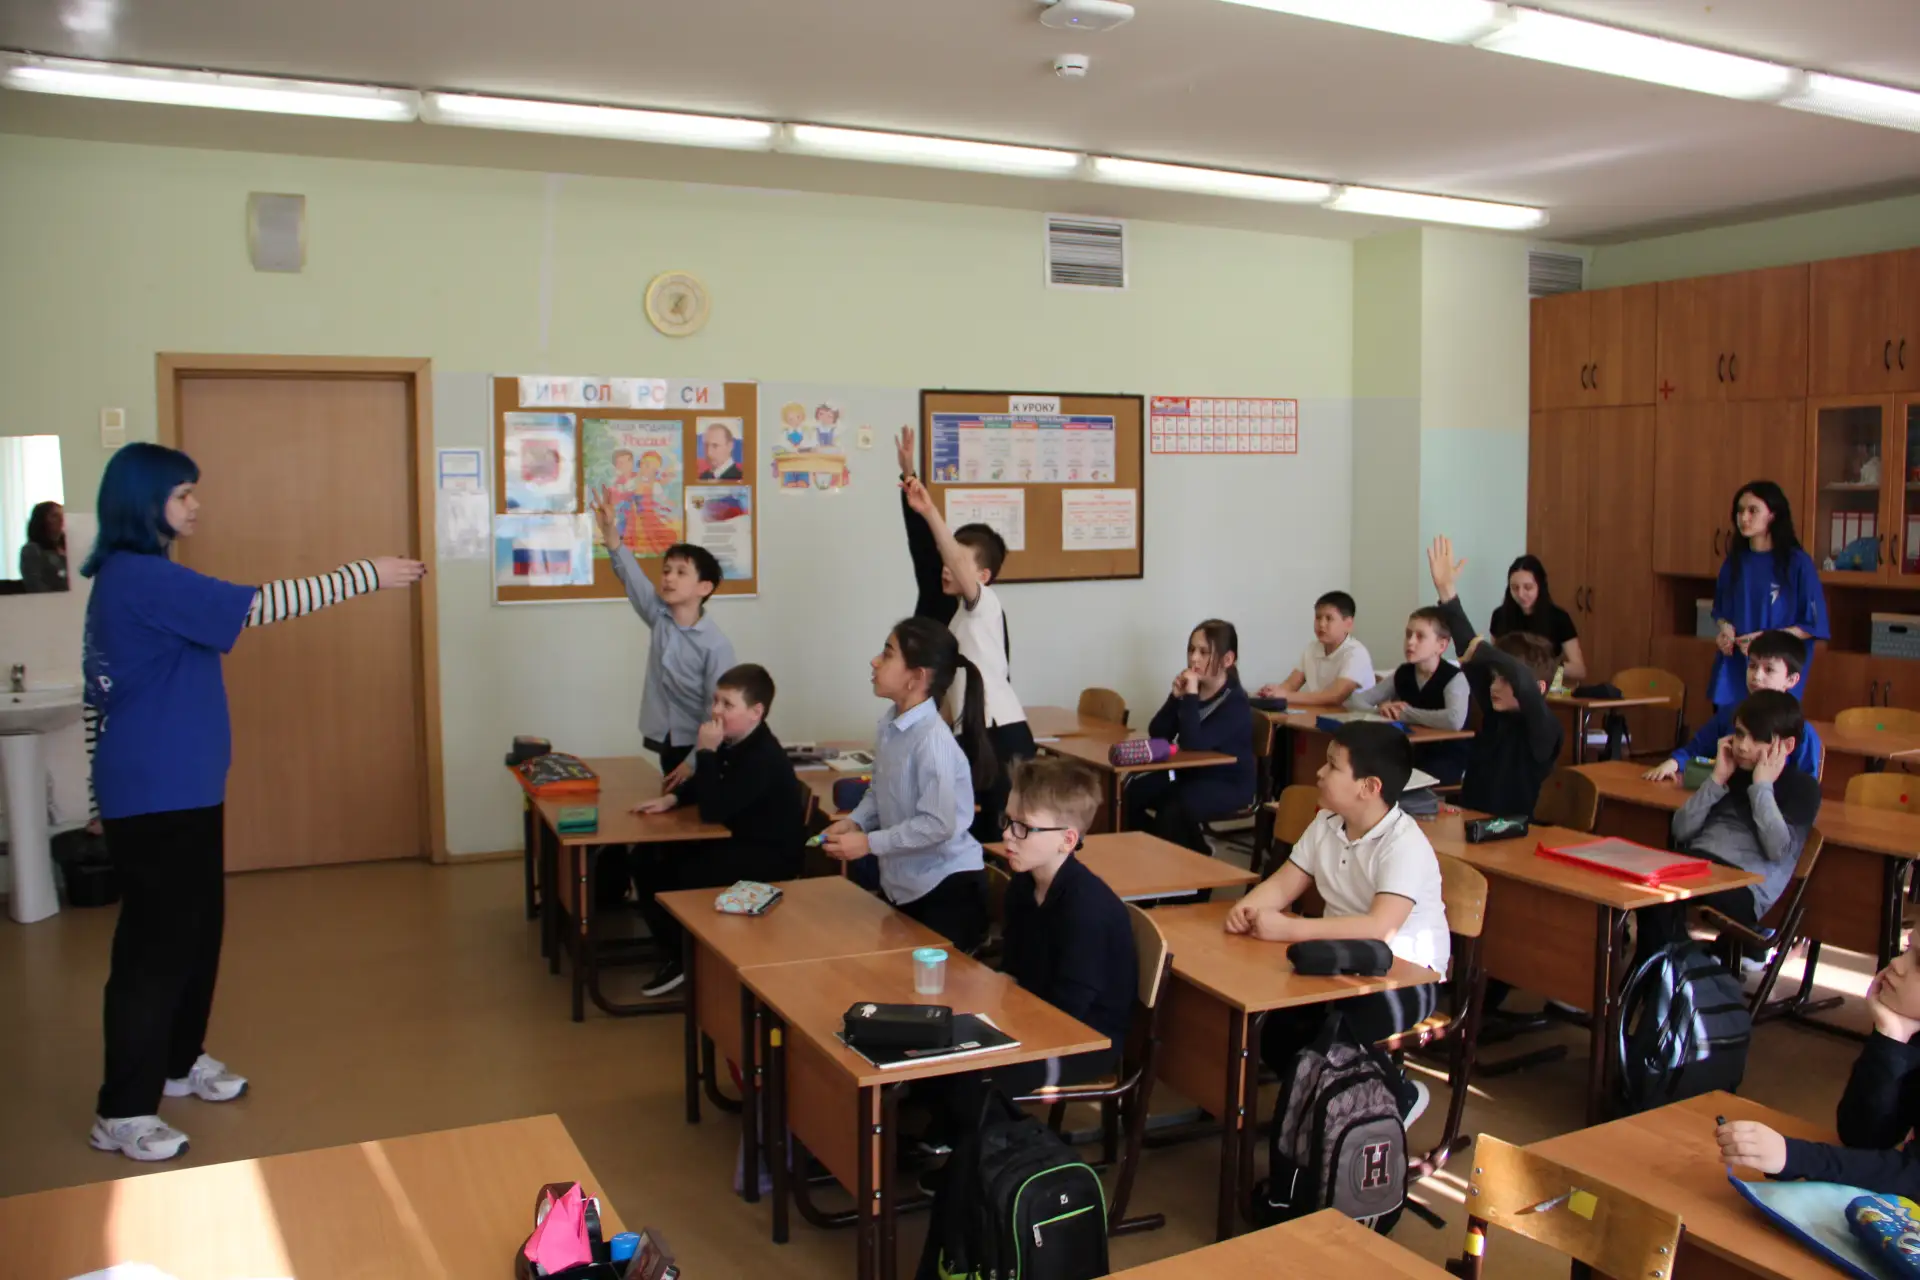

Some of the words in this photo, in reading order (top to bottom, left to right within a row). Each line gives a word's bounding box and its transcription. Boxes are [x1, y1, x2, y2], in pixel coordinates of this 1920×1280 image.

[1012, 403, 1019, 412] К
[1022, 403, 1055, 413] УРОКУ
[1361, 1141, 1391, 1190] H
